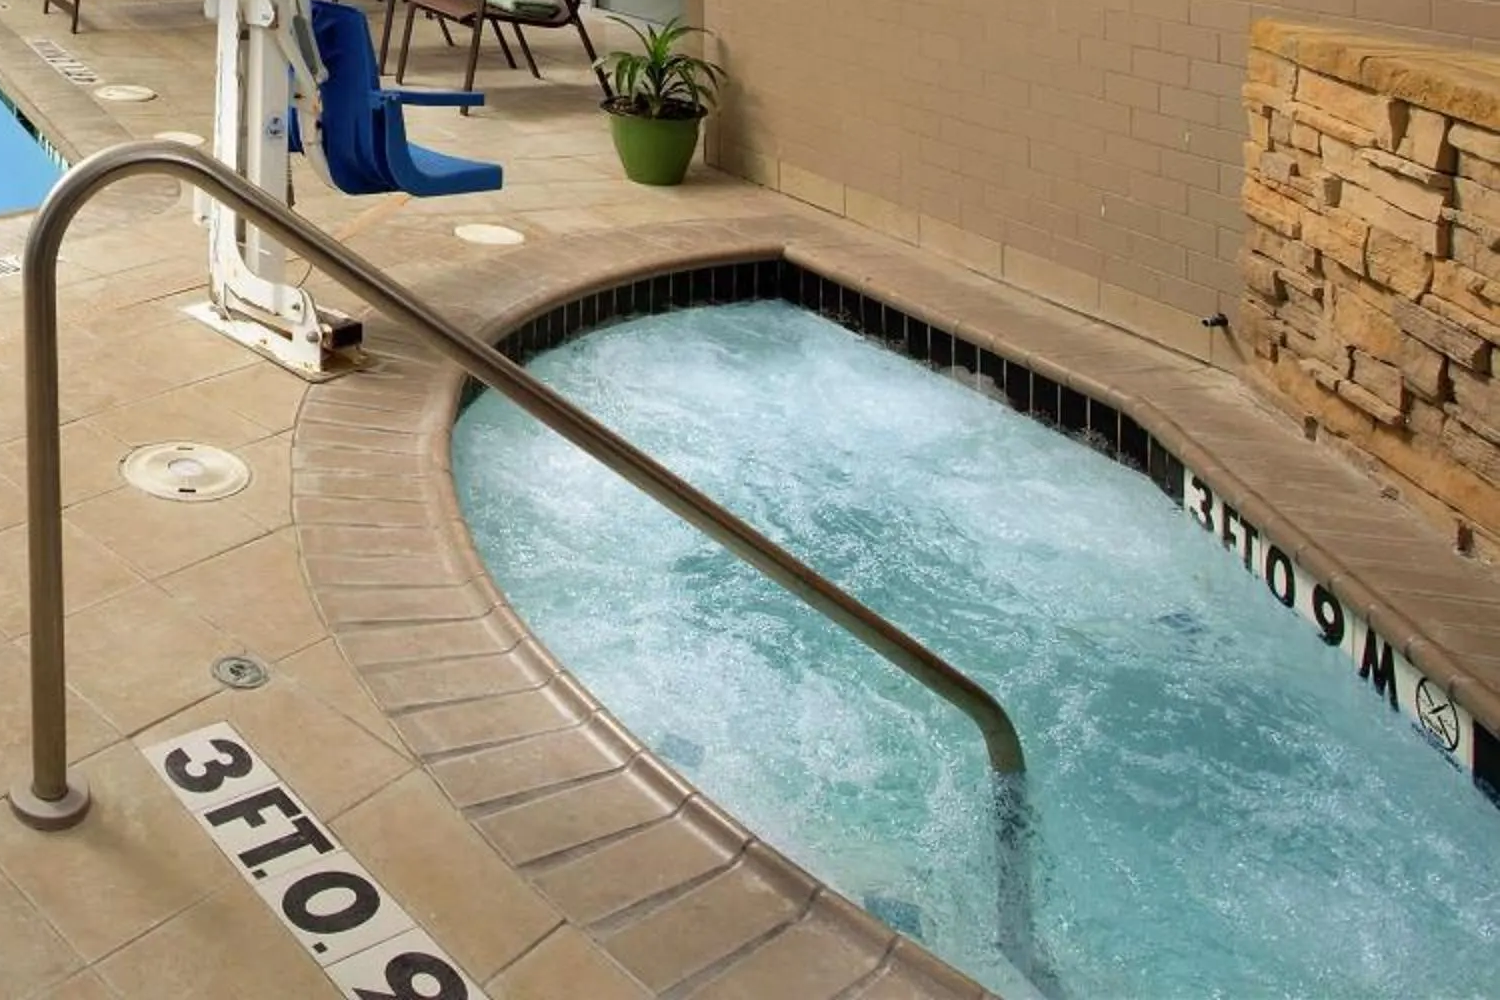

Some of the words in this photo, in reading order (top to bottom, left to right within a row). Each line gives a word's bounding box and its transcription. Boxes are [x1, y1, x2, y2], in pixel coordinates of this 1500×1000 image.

[1187, 475, 1215, 532] 3
[1358, 622, 1399, 713] M
[165, 739, 253, 793] 3
